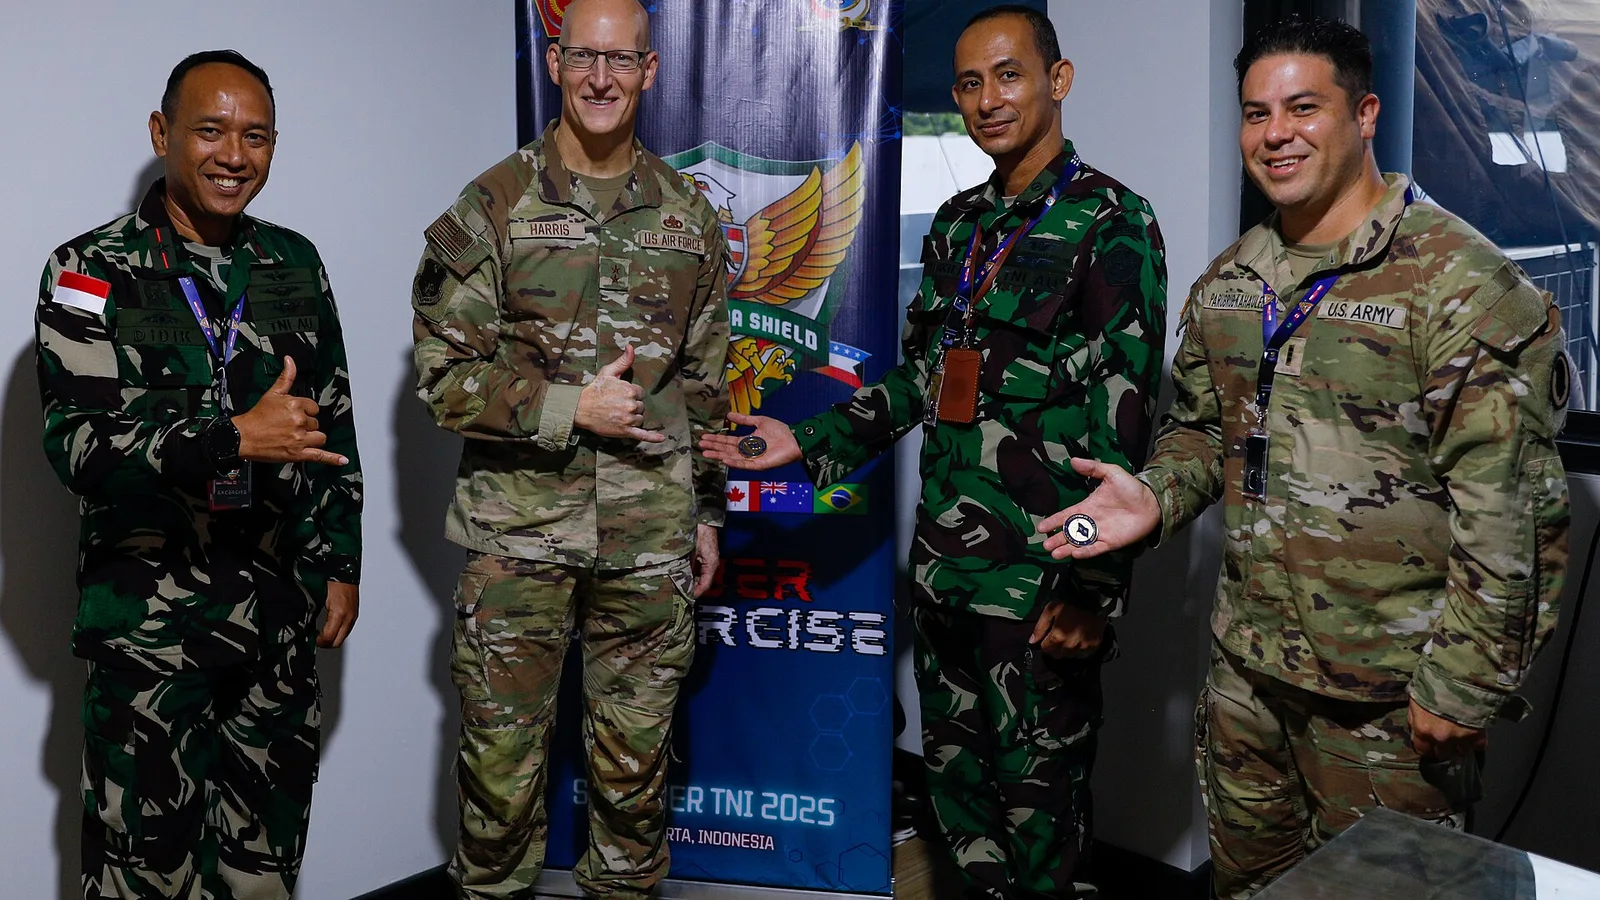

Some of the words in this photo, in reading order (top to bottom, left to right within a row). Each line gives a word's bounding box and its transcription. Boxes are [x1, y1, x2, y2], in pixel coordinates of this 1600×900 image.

[530, 223, 570, 236] HARRIS
[661, 234, 676, 247] AIR
[678, 236, 701, 251] FORCE
[1328, 302, 1347, 318] U.S.
[1350, 304, 1395, 324] ARMY
[133, 328, 191, 343] DIDIK
[268, 320, 292, 332] TNI
[298, 318, 313, 330] AU
[728, 308, 743, 327] A
[749, 312, 818, 351] SHIELD
[702, 557, 813, 602] ER
[697, 604, 887, 656] RCISE
[710, 787, 754, 818] TNI
[761, 791, 836, 827] 2025
[666, 827, 695, 845] RTA,
[698, 829, 775, 851] INDONESIA
